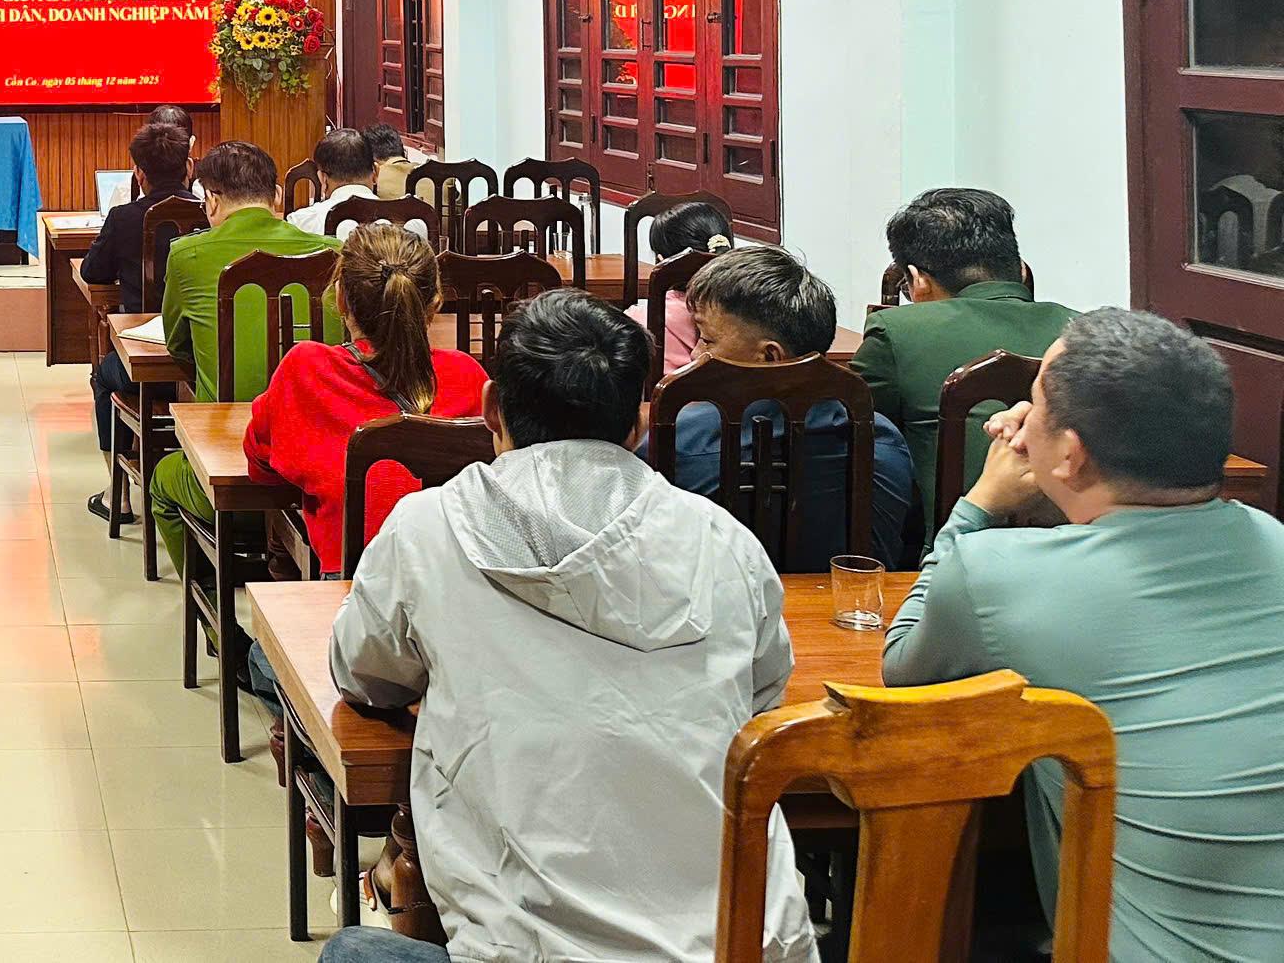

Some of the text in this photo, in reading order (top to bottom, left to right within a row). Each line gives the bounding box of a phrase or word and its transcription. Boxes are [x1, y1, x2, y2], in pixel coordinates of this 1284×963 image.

[9, 5, 47, 23] DÂN,
[49, 7, 105, 21] DOANH
[109, 5, 170, 24] NGHIỆP
[172, 3, 209, 20] NĂM
